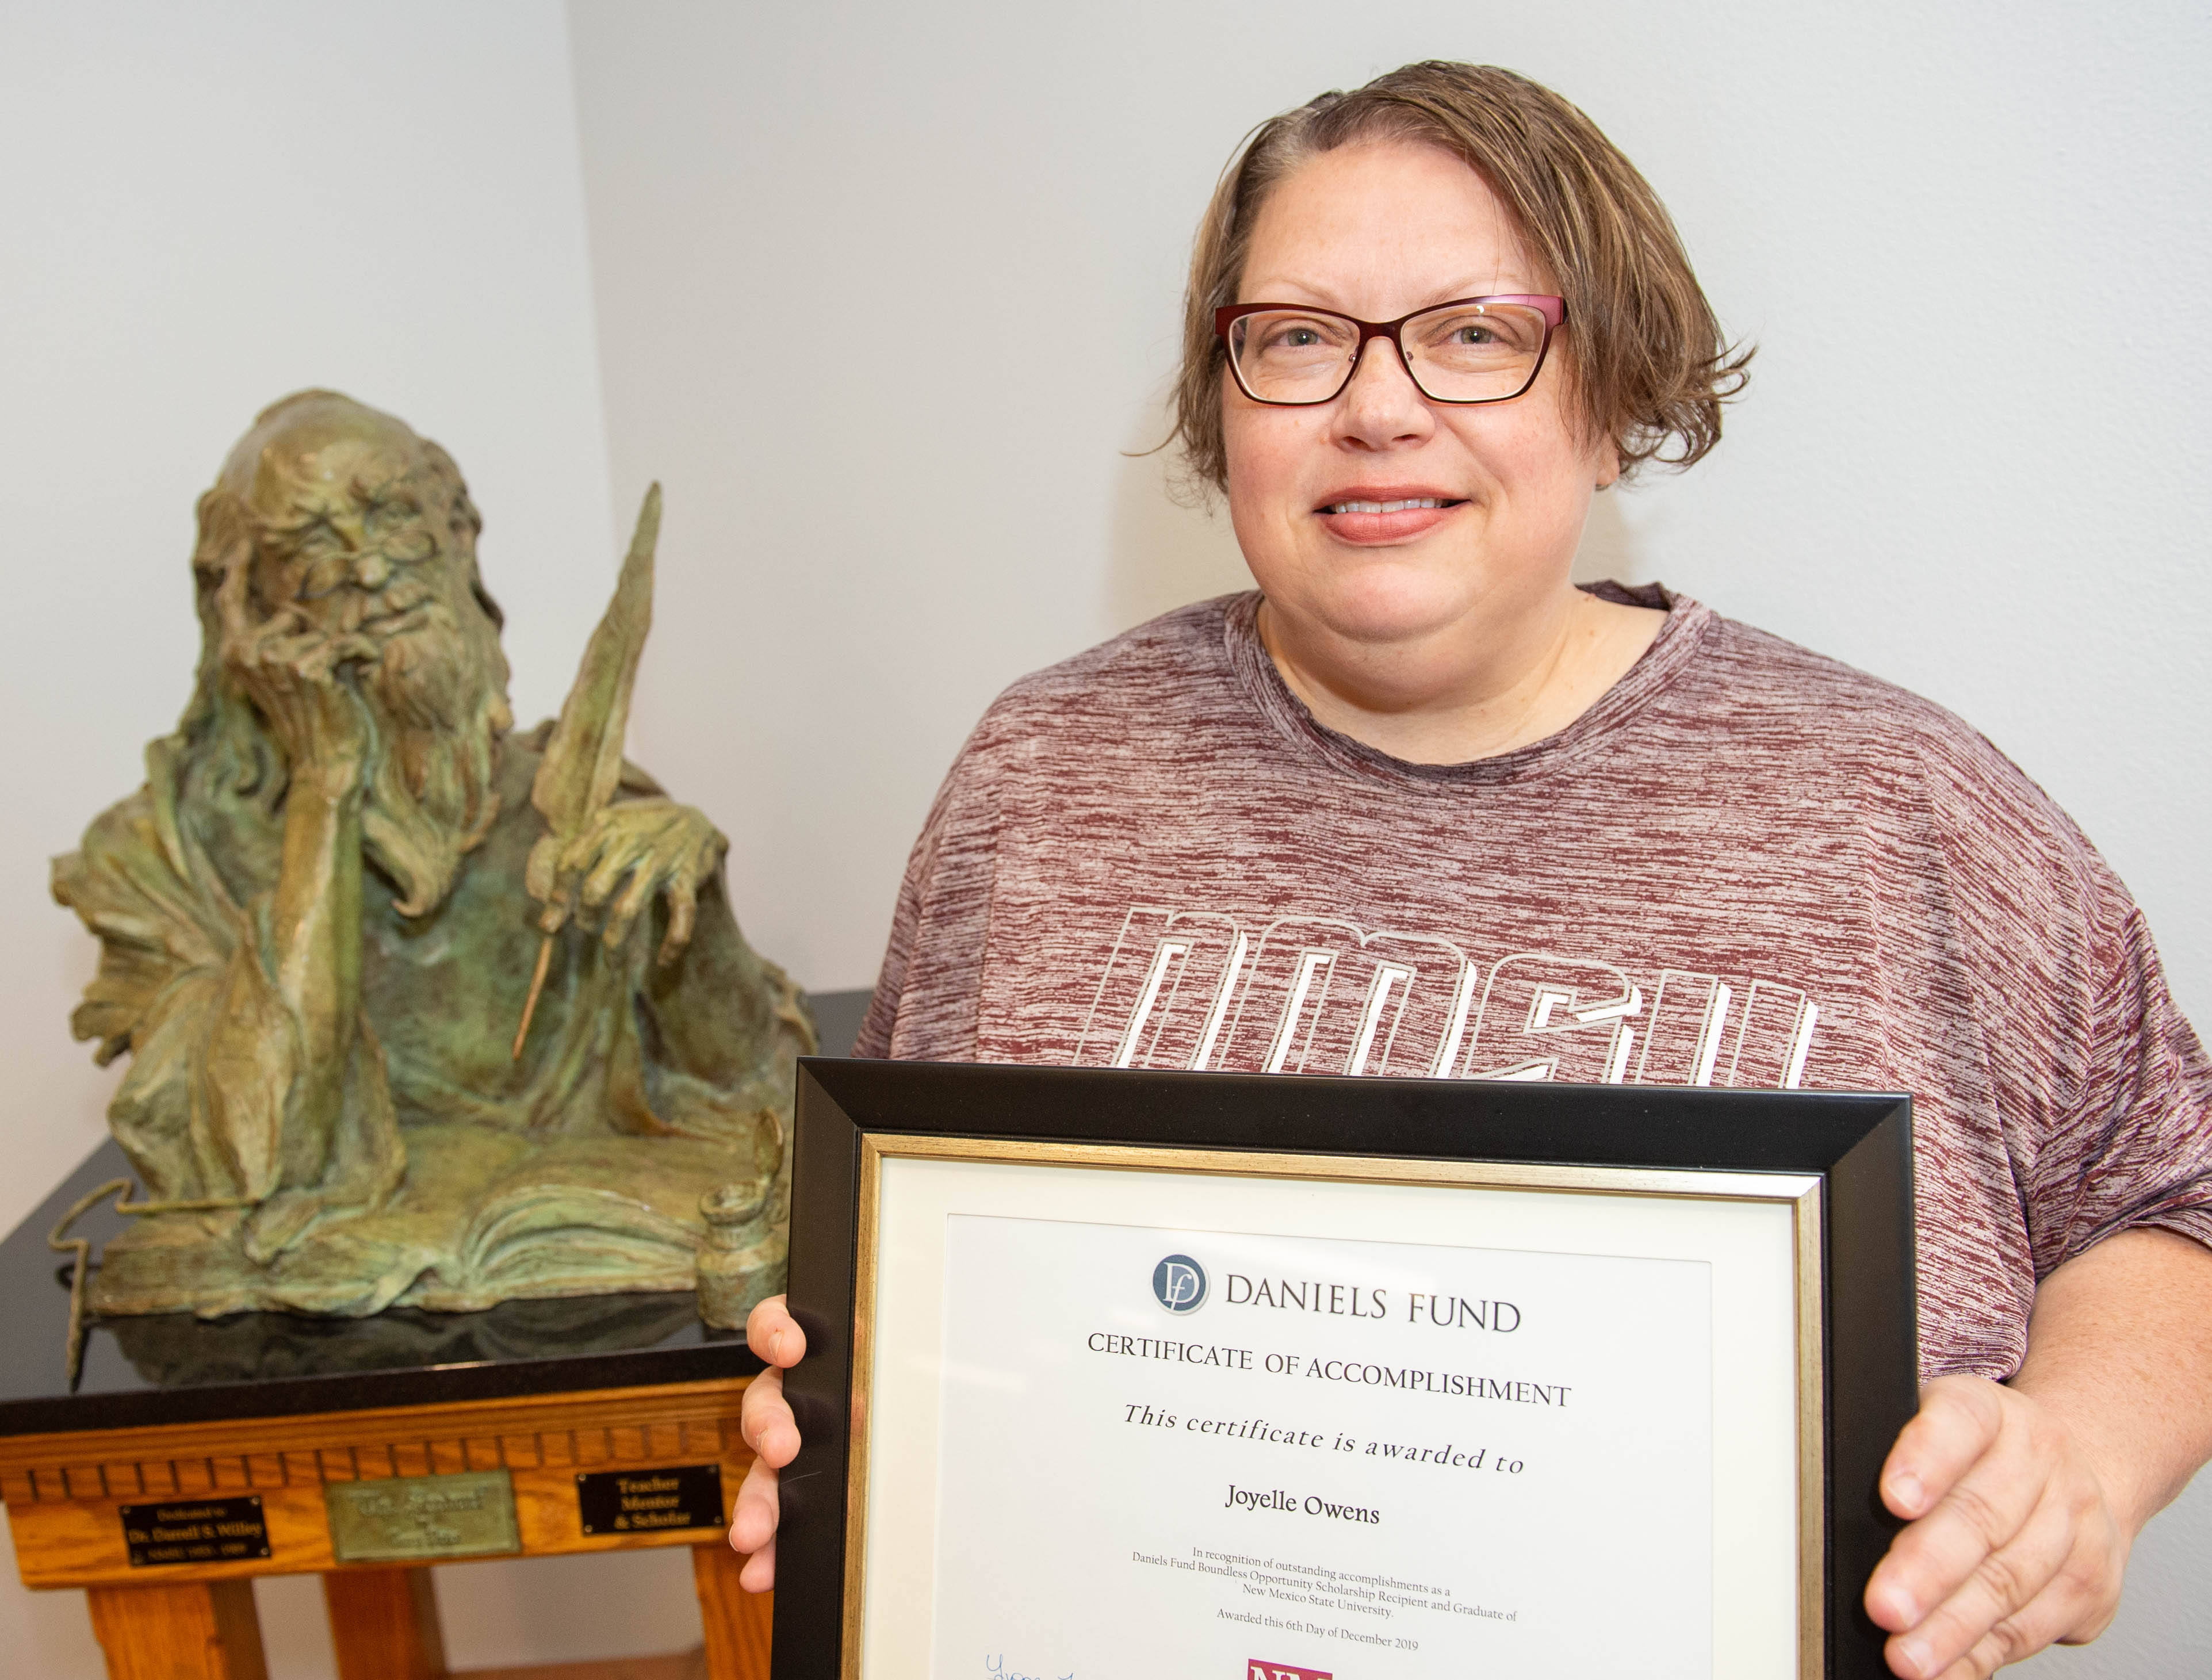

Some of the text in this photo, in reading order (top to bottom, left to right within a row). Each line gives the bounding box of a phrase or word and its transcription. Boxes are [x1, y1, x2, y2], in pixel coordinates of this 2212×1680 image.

[1226, 1274, 1521, 1333] DANIELS FUND
[1088, 1333, 1571, 1407] CERTIFICATE OF ACCOMPLISHMENT
[1124, 1405, 1523, 1474] This certificate is awarded to
[1225, 1484, 1379, 1524] Joyelle Owens
[1133, 1552, 1517, 1621] Daniels Fund Boundless Opportunity Scholarship Recipient and Graduate of
[1193, 1547, 1202, 1557] In
[1205, 1552, 1260, 1566] recognition
[1264, 1558, 1274, 1568] of
[1276, 1563, 1336, 1581] outstanding
[1339, 1573, 1428, 1593] accomplishments
[1243, 1583, 1394, 1619] New Mexico State University.
[1217, 1609, 1418, 1650] Awarded this 6th Day of December 2019
